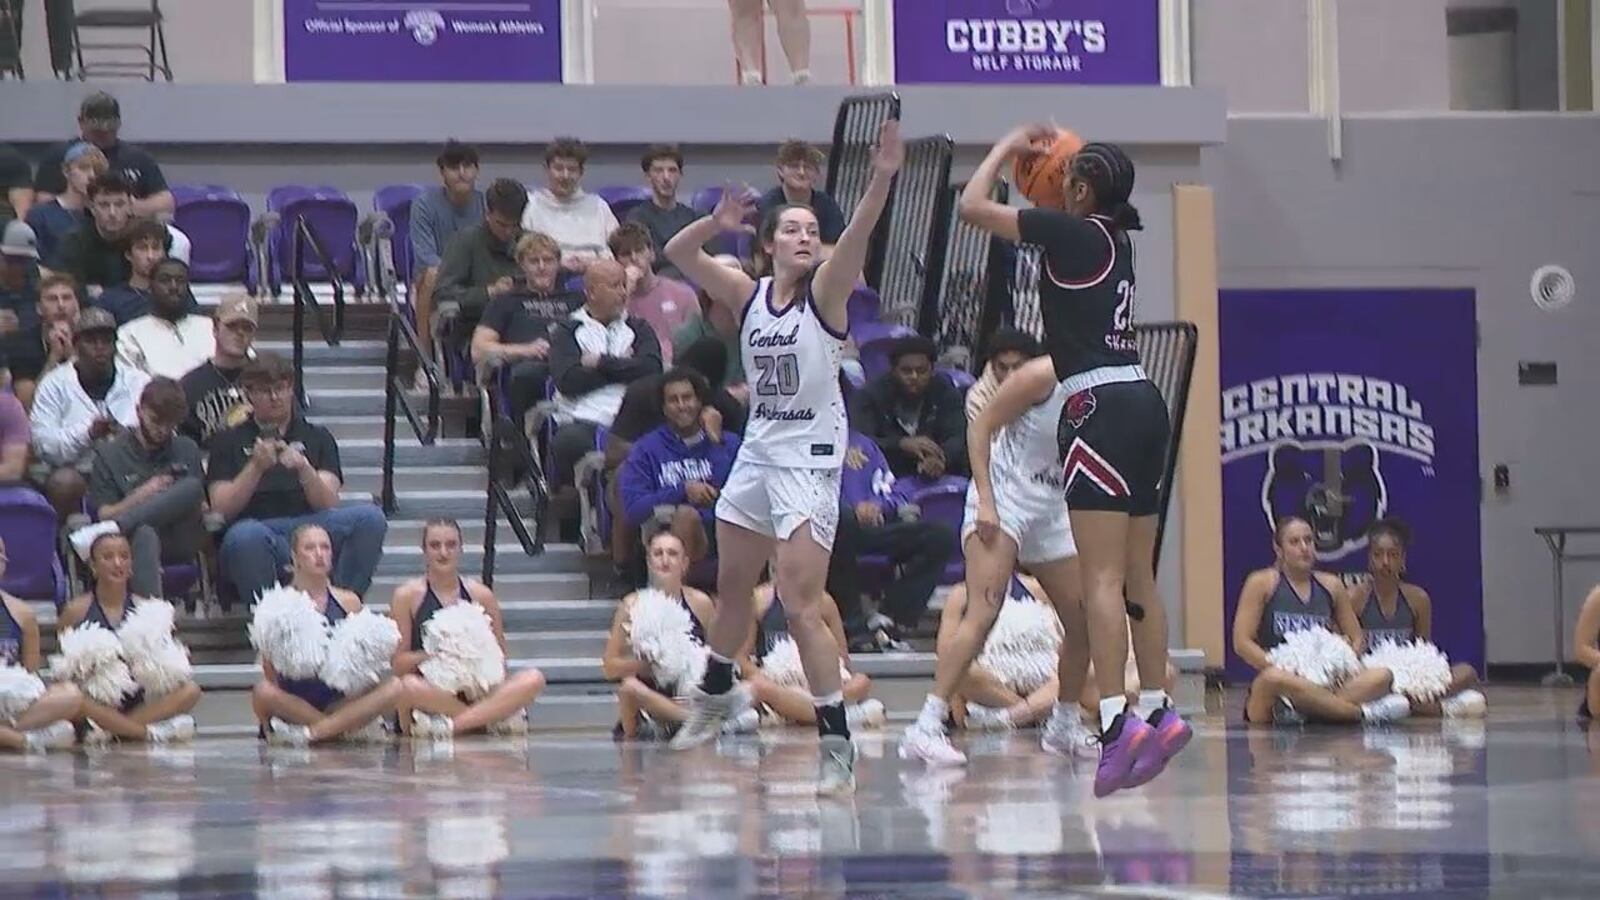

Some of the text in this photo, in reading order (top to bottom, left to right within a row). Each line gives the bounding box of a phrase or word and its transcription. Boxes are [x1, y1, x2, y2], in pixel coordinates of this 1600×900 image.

[304, 17, 545, 35] Official Sponsor of Women's Athletics
[946, 19, 1107, 53] CUBBY'S
[972, 54, 1081, 71] SELF STORAGE
[749, 325, 799, 347] Central
[754, 353, 800, 396] 20
[1221, 373, 1424, 421] CENTRAL
